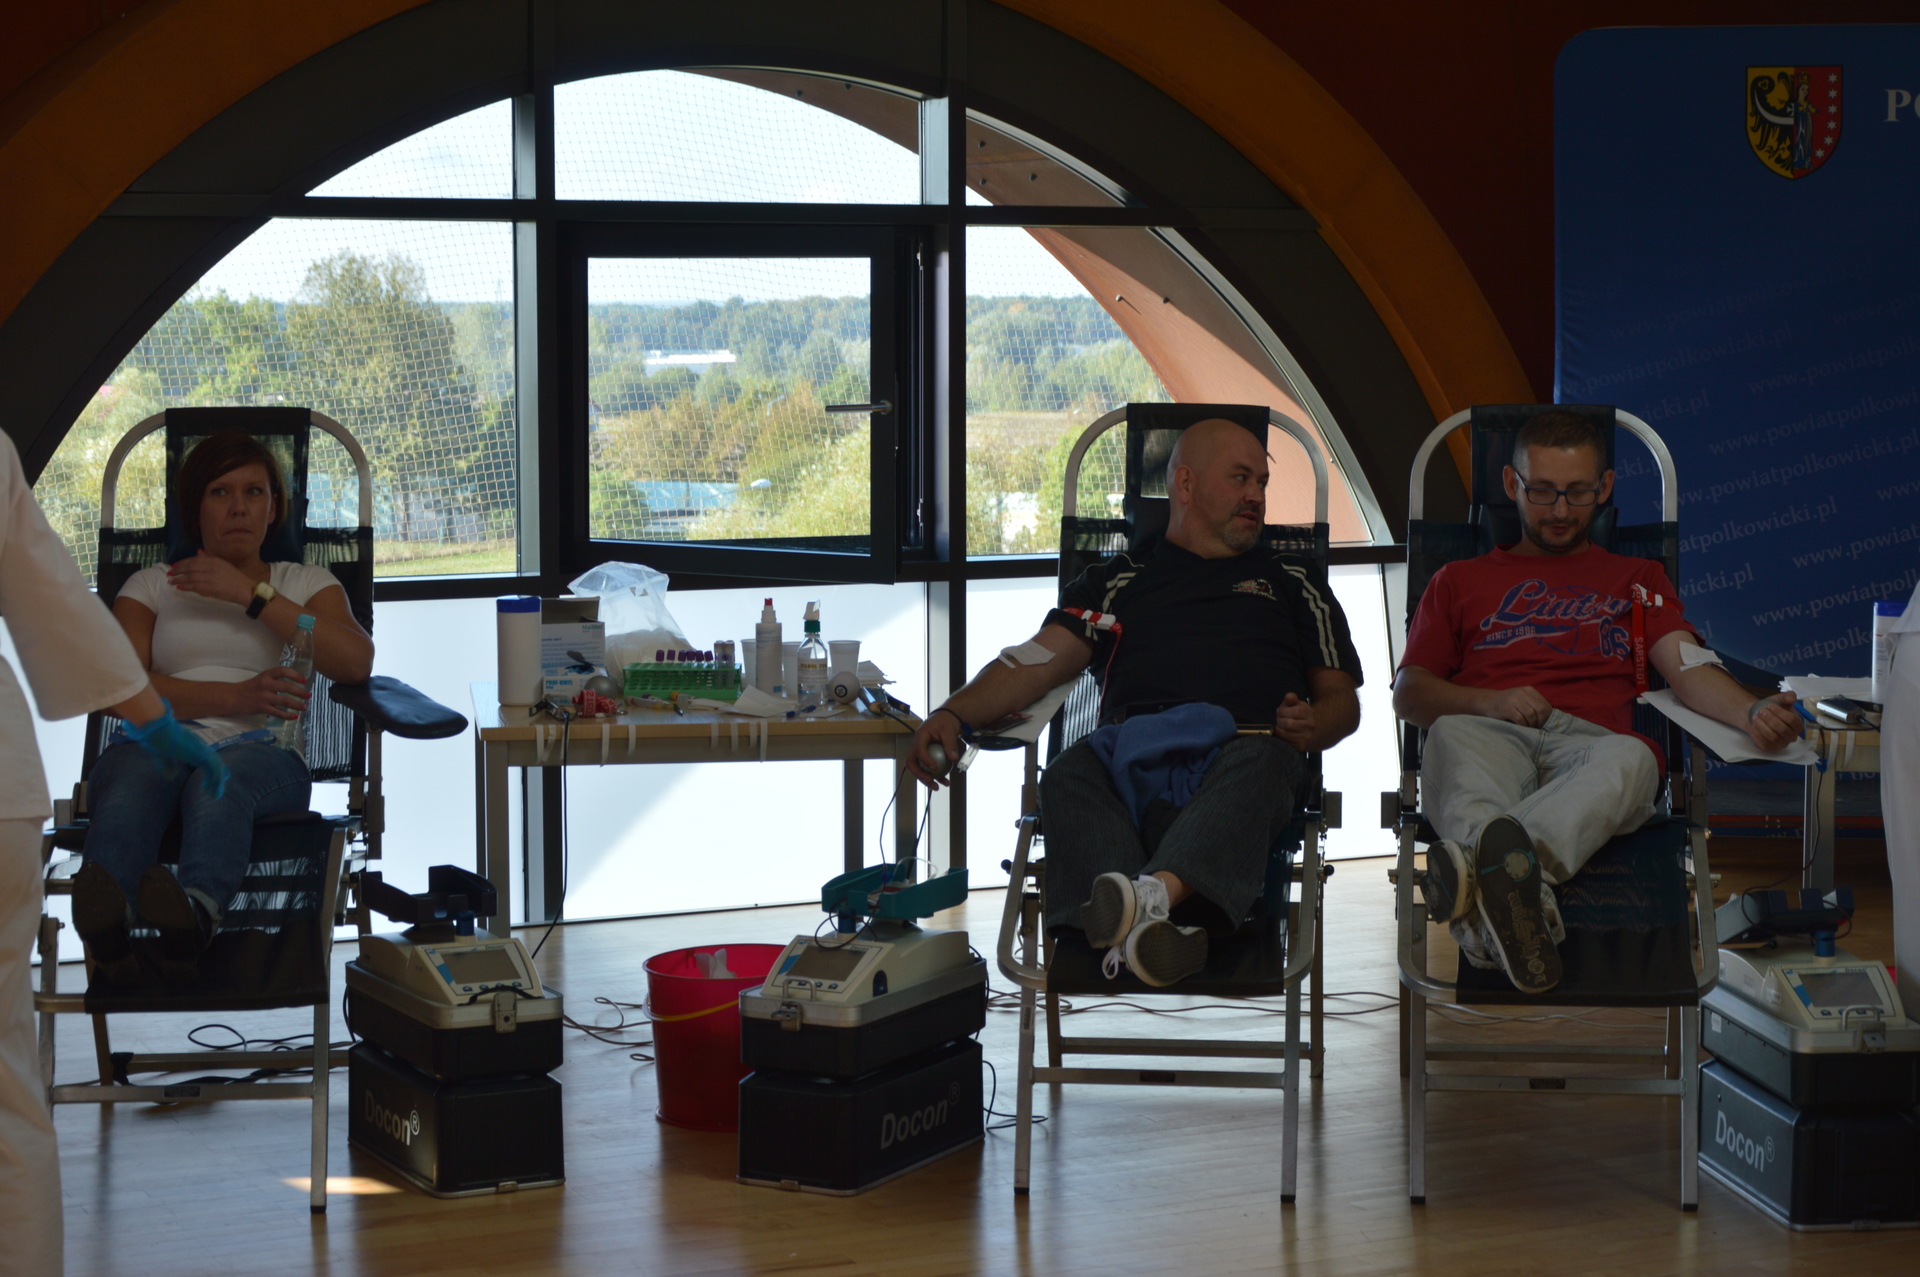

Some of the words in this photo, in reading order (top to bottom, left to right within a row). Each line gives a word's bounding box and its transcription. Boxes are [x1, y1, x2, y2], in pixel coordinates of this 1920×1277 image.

[1883, 88, 1920, 122] P
[1486, 628, 1512, 642] SINCE
[1634, 637, 1646, 685] SARSTEDT
